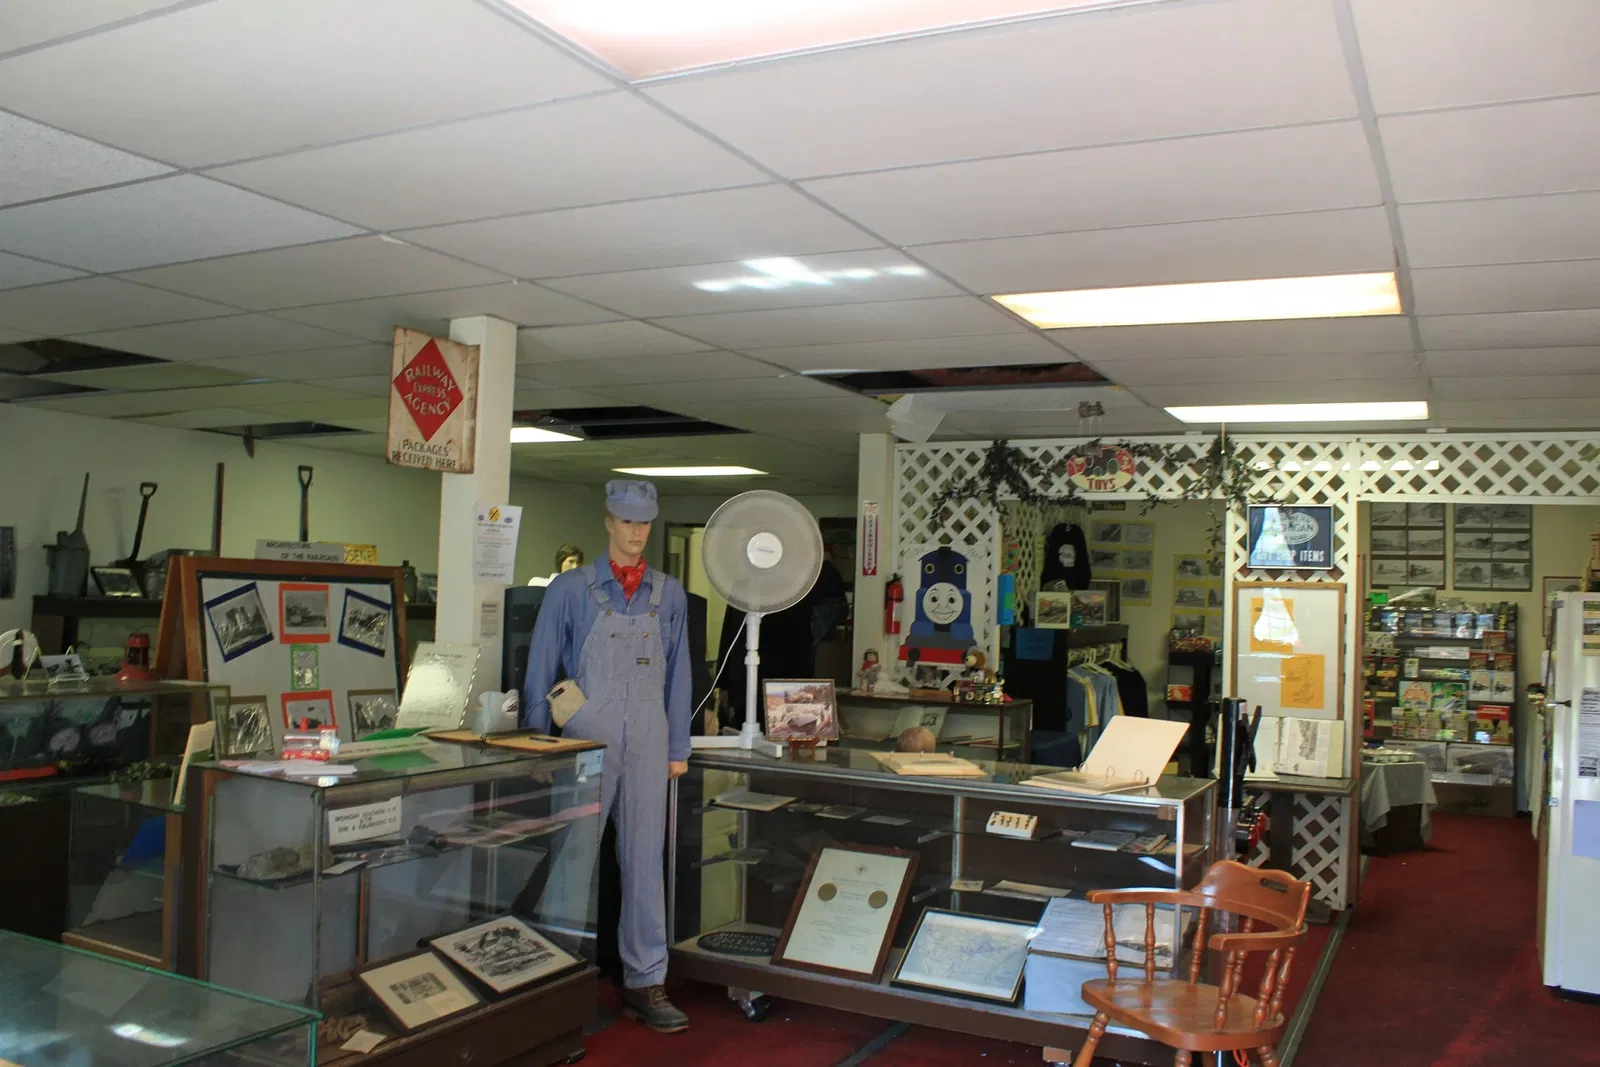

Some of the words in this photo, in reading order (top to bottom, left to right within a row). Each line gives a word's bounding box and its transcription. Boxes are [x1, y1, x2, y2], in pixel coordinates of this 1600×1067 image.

[404, 364, 456, 391] RAILWAY
[413, 382, 446, 399] EXPRESS
[403, 392, 452, 415] AGENCY
[402, 439, 449, 457] PACKAGES
[391, 450, 432, 465] RECEIVED
[435, 455, 457, 470] HERE
[1087, 477, 1116, 490] TOYS
[280, 551, 289, 559] OF
[292, 552, 303, 560] THE
[1300, 550, 1324, 562] ITEMS
